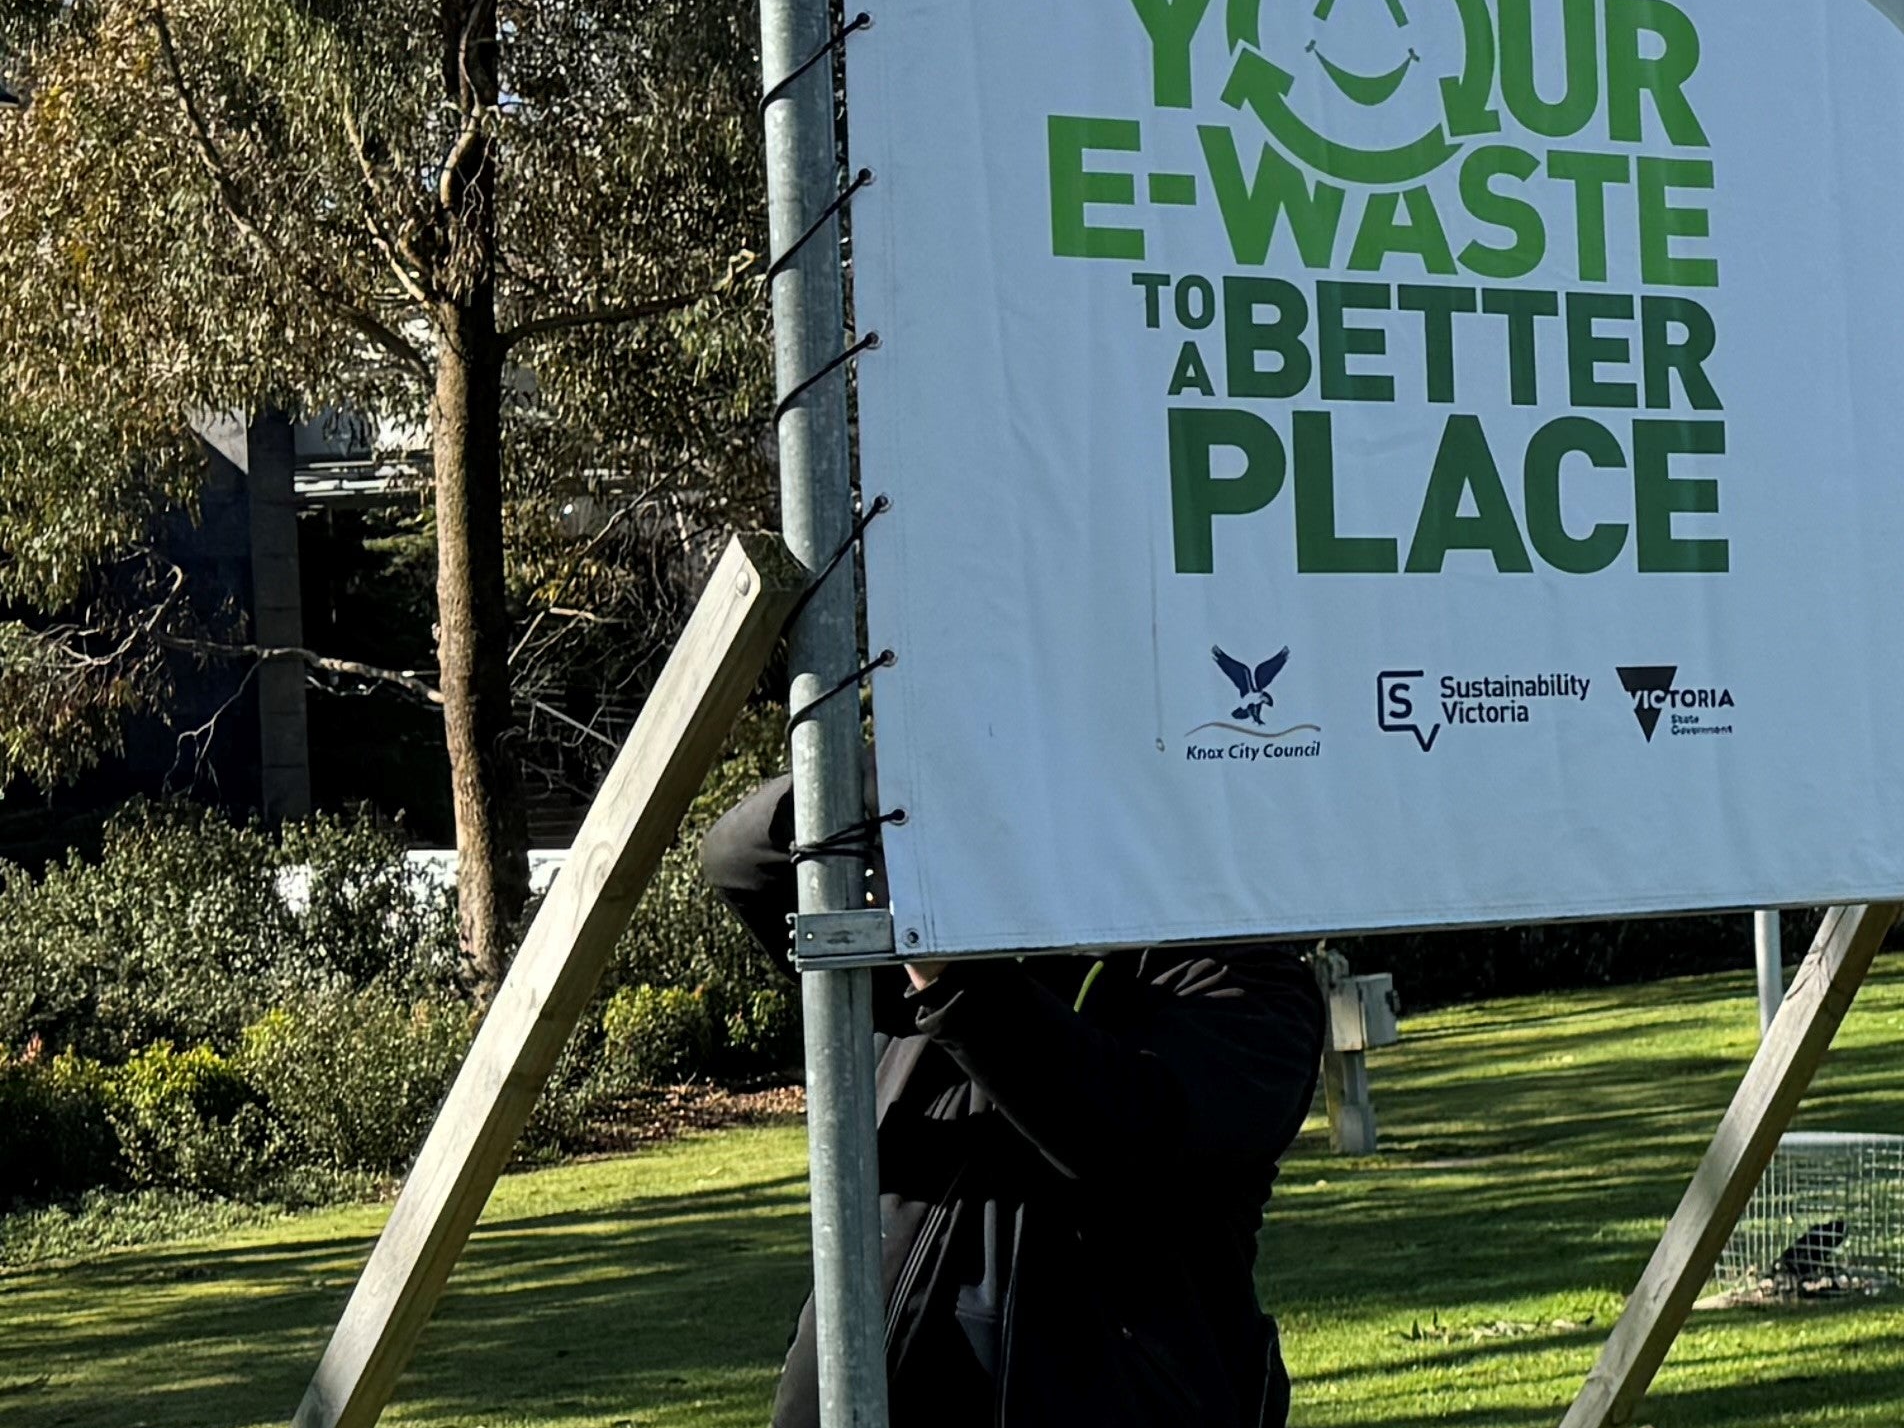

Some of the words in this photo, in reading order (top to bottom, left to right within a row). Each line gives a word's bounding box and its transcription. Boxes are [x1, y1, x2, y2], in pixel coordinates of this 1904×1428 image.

[1047, 114, 1720, 288] E-WASTE
[1131, 273, 1216, 330] TO
[1166, 341, 1216, 397] A
[1222, 275, 1725, 411] BETTER
[1166, 406, 1730, 575] PLACE
[1439, 674, 1591, 701] Sustainability
[1631, 688, 1736, 710] VICTORIA
[1441, 700, 1530, 725] Victoria
[1186, 744, 1224, 761] Knox
[1228, 742, 1260, 762] City
[1263, 740, 1321, 759] Council
